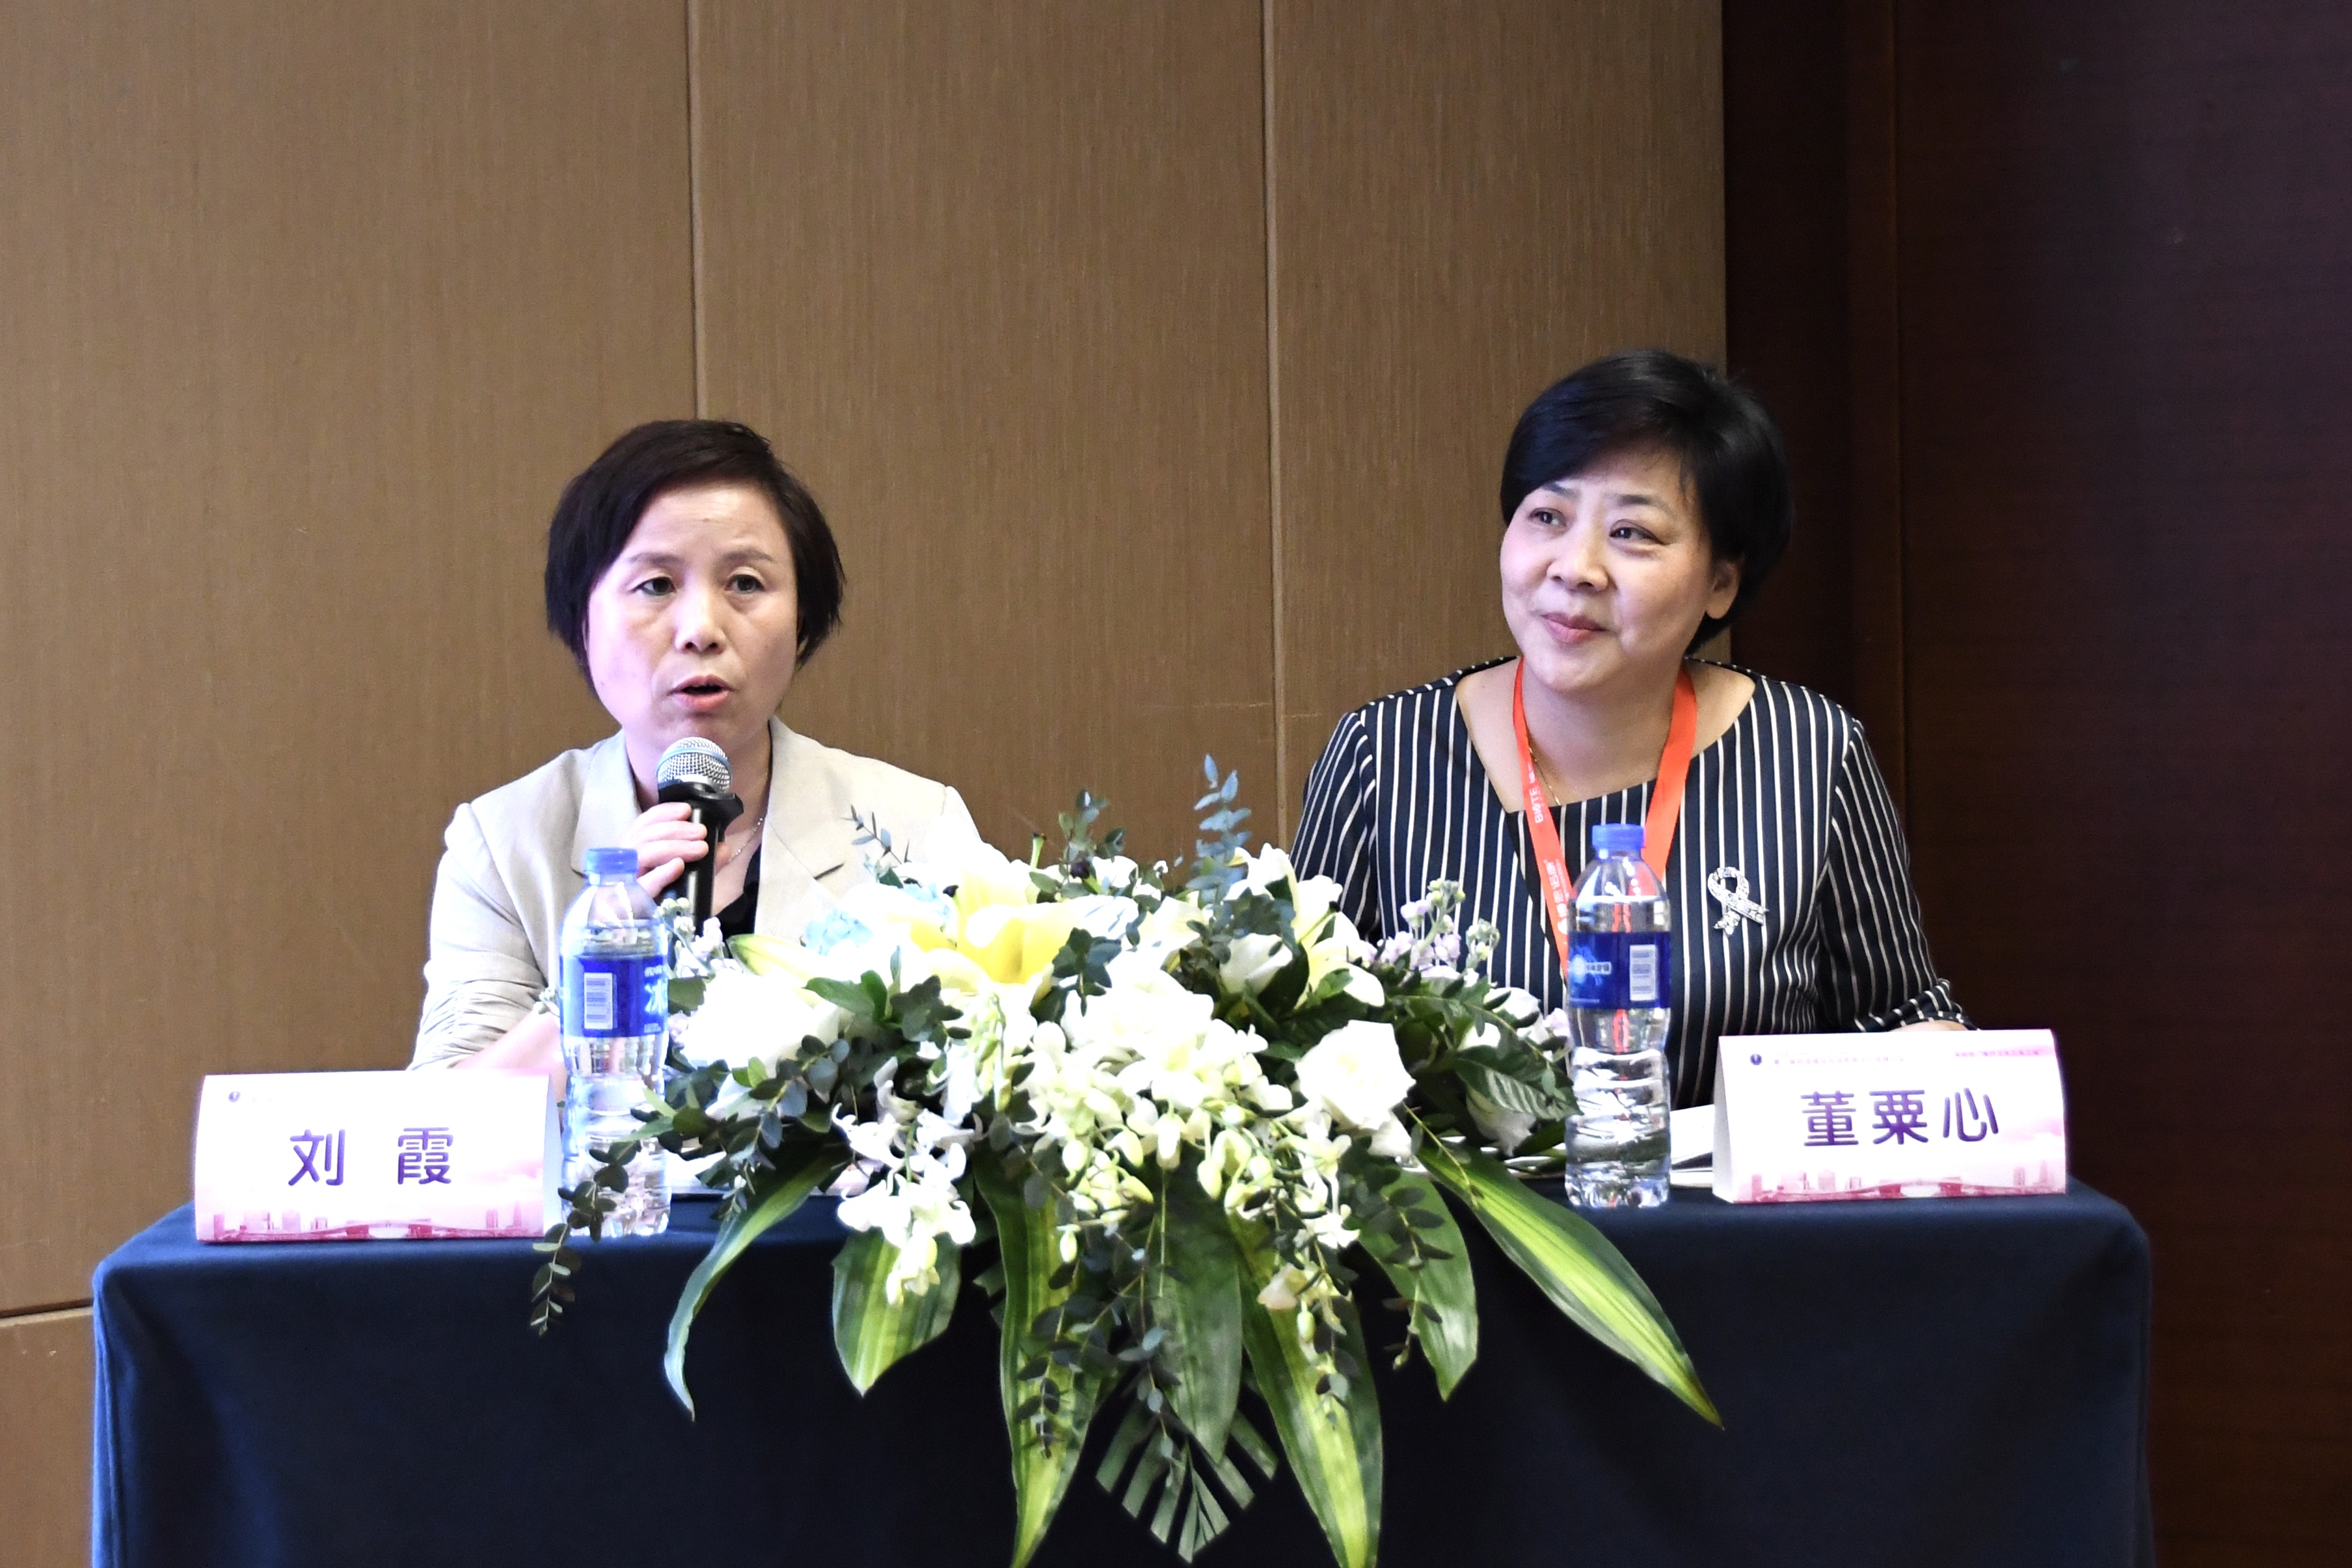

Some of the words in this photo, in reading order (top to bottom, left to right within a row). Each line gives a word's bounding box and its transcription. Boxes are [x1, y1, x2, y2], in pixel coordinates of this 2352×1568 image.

[1801, 1088, 1999, 1147] 董粟心
[288, 1128, 453, 1187] 刘霞
